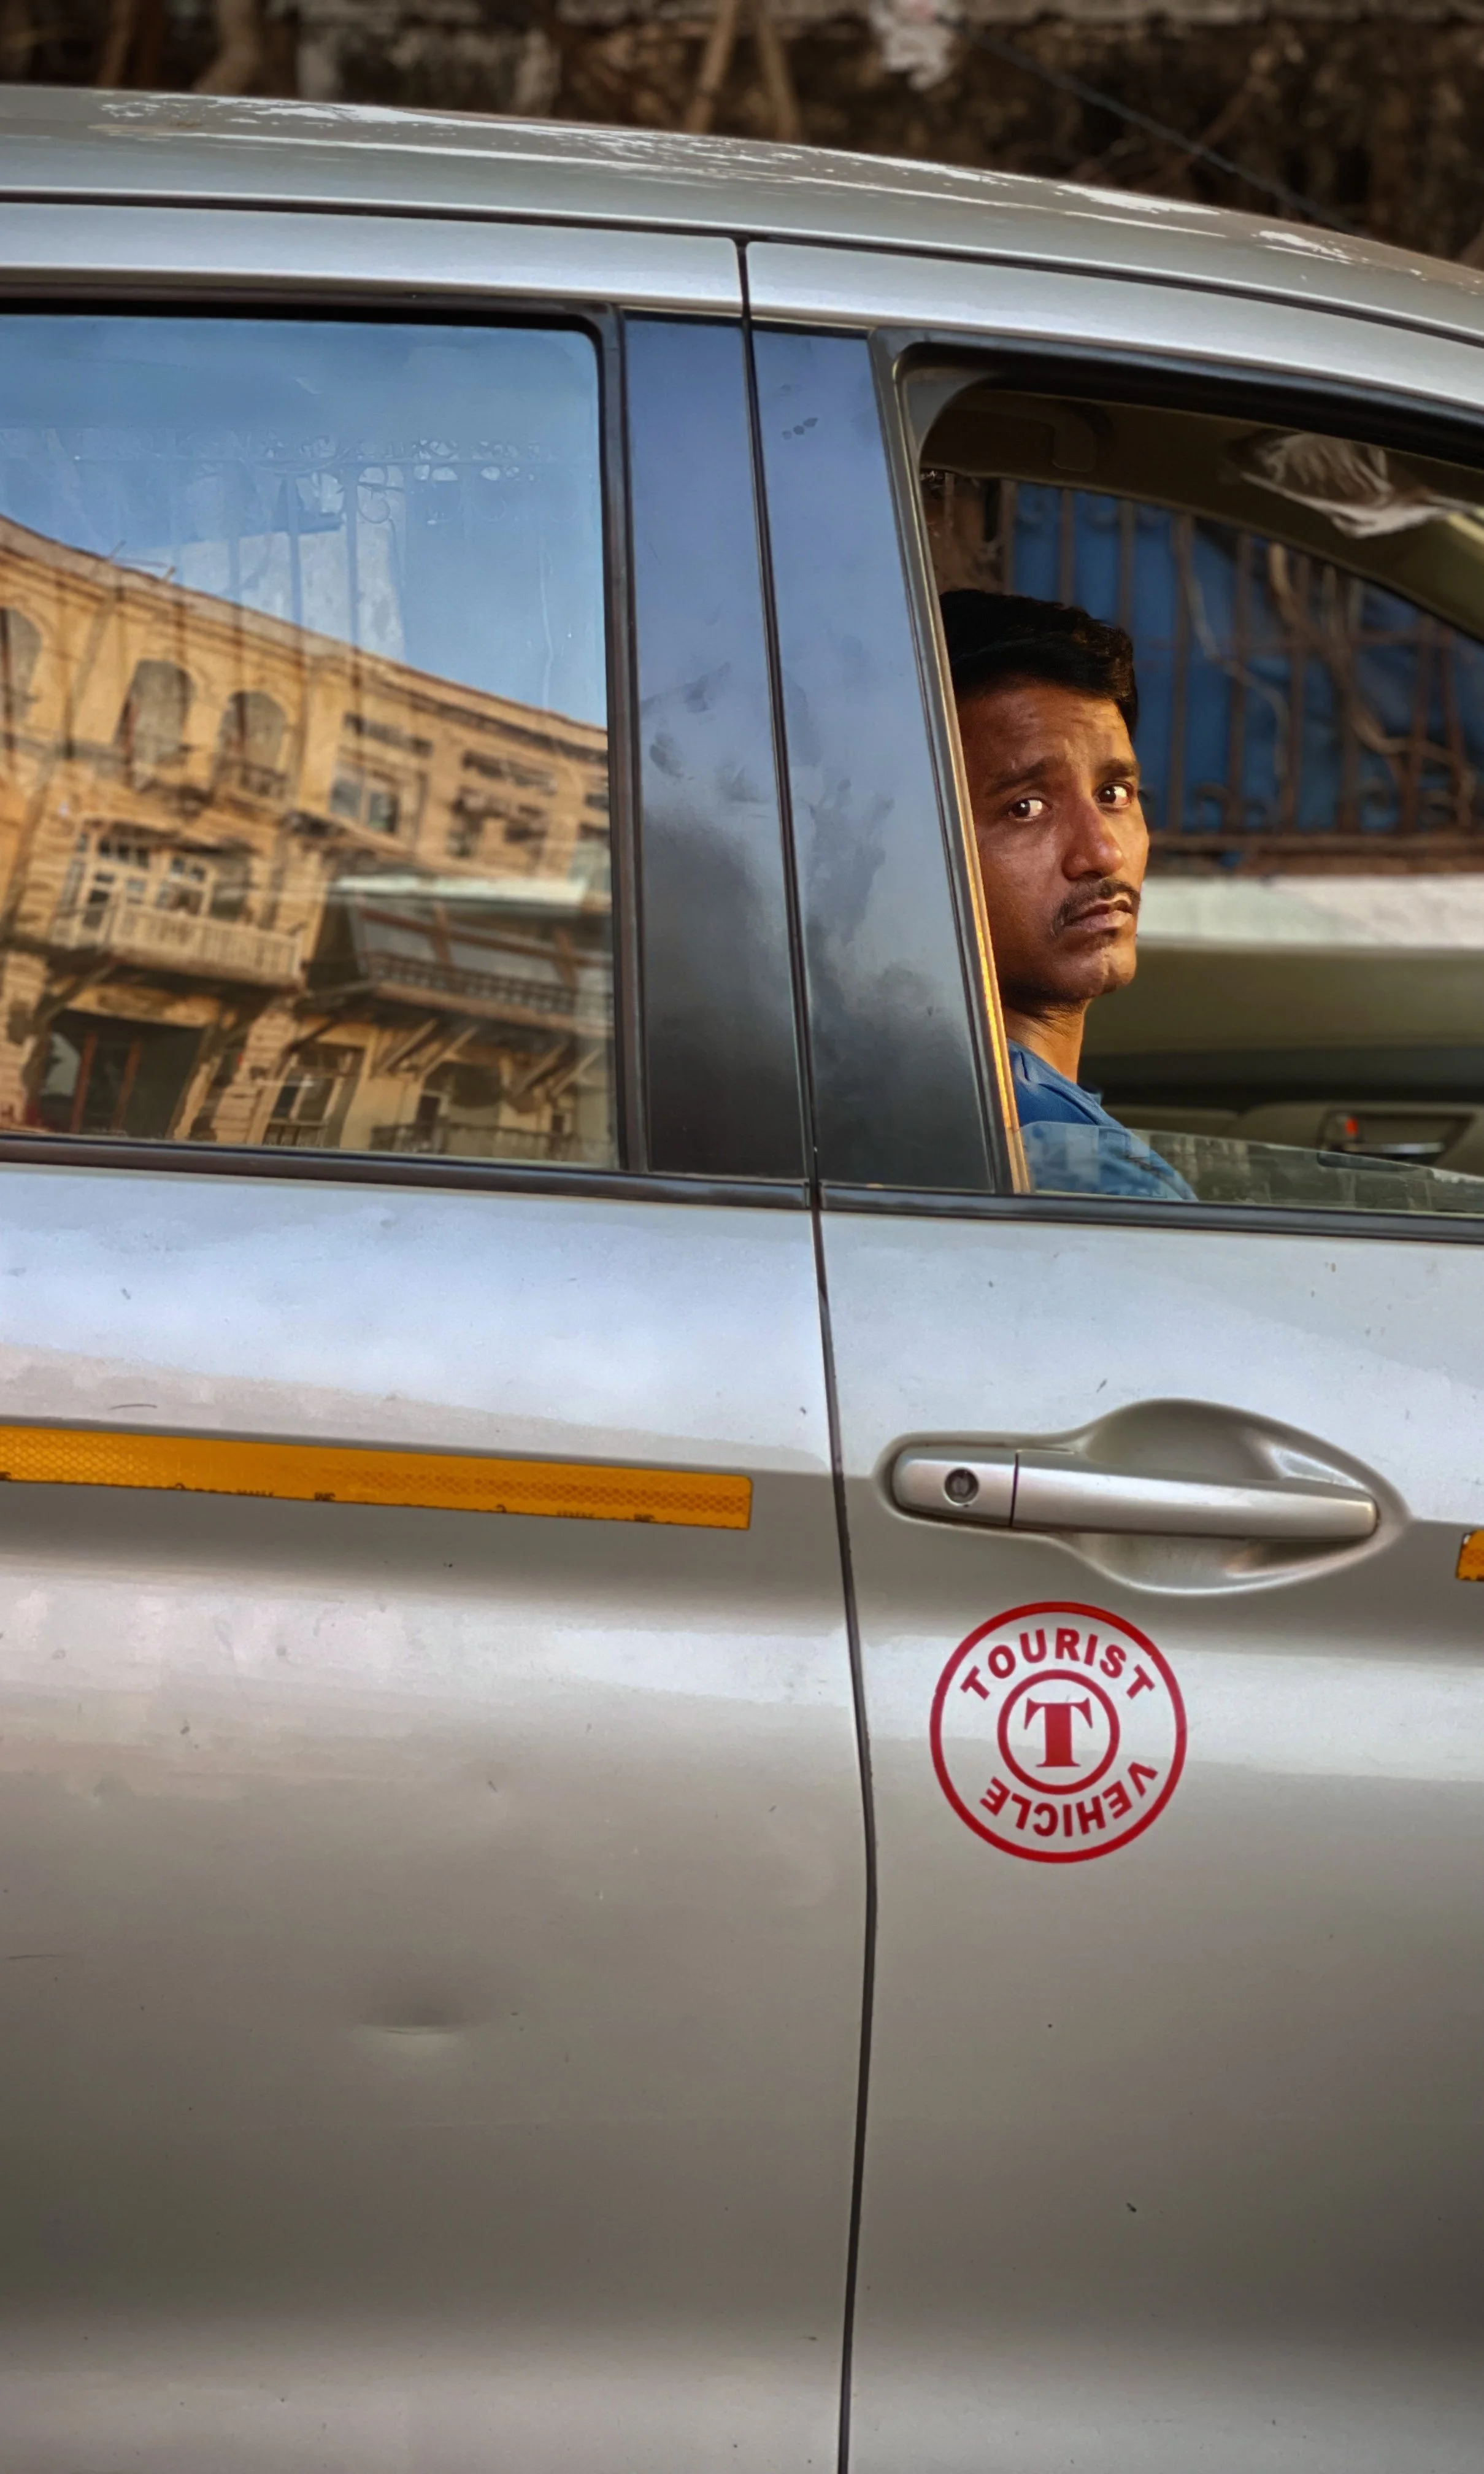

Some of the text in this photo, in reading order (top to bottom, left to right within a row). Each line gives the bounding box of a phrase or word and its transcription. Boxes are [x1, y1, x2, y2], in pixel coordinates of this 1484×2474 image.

[960, 1627, 1155, 1700] TOURIST
[1024, 1697, 1093, 1768] T
[979, 1762, 1158, 1838] VEHICLE
